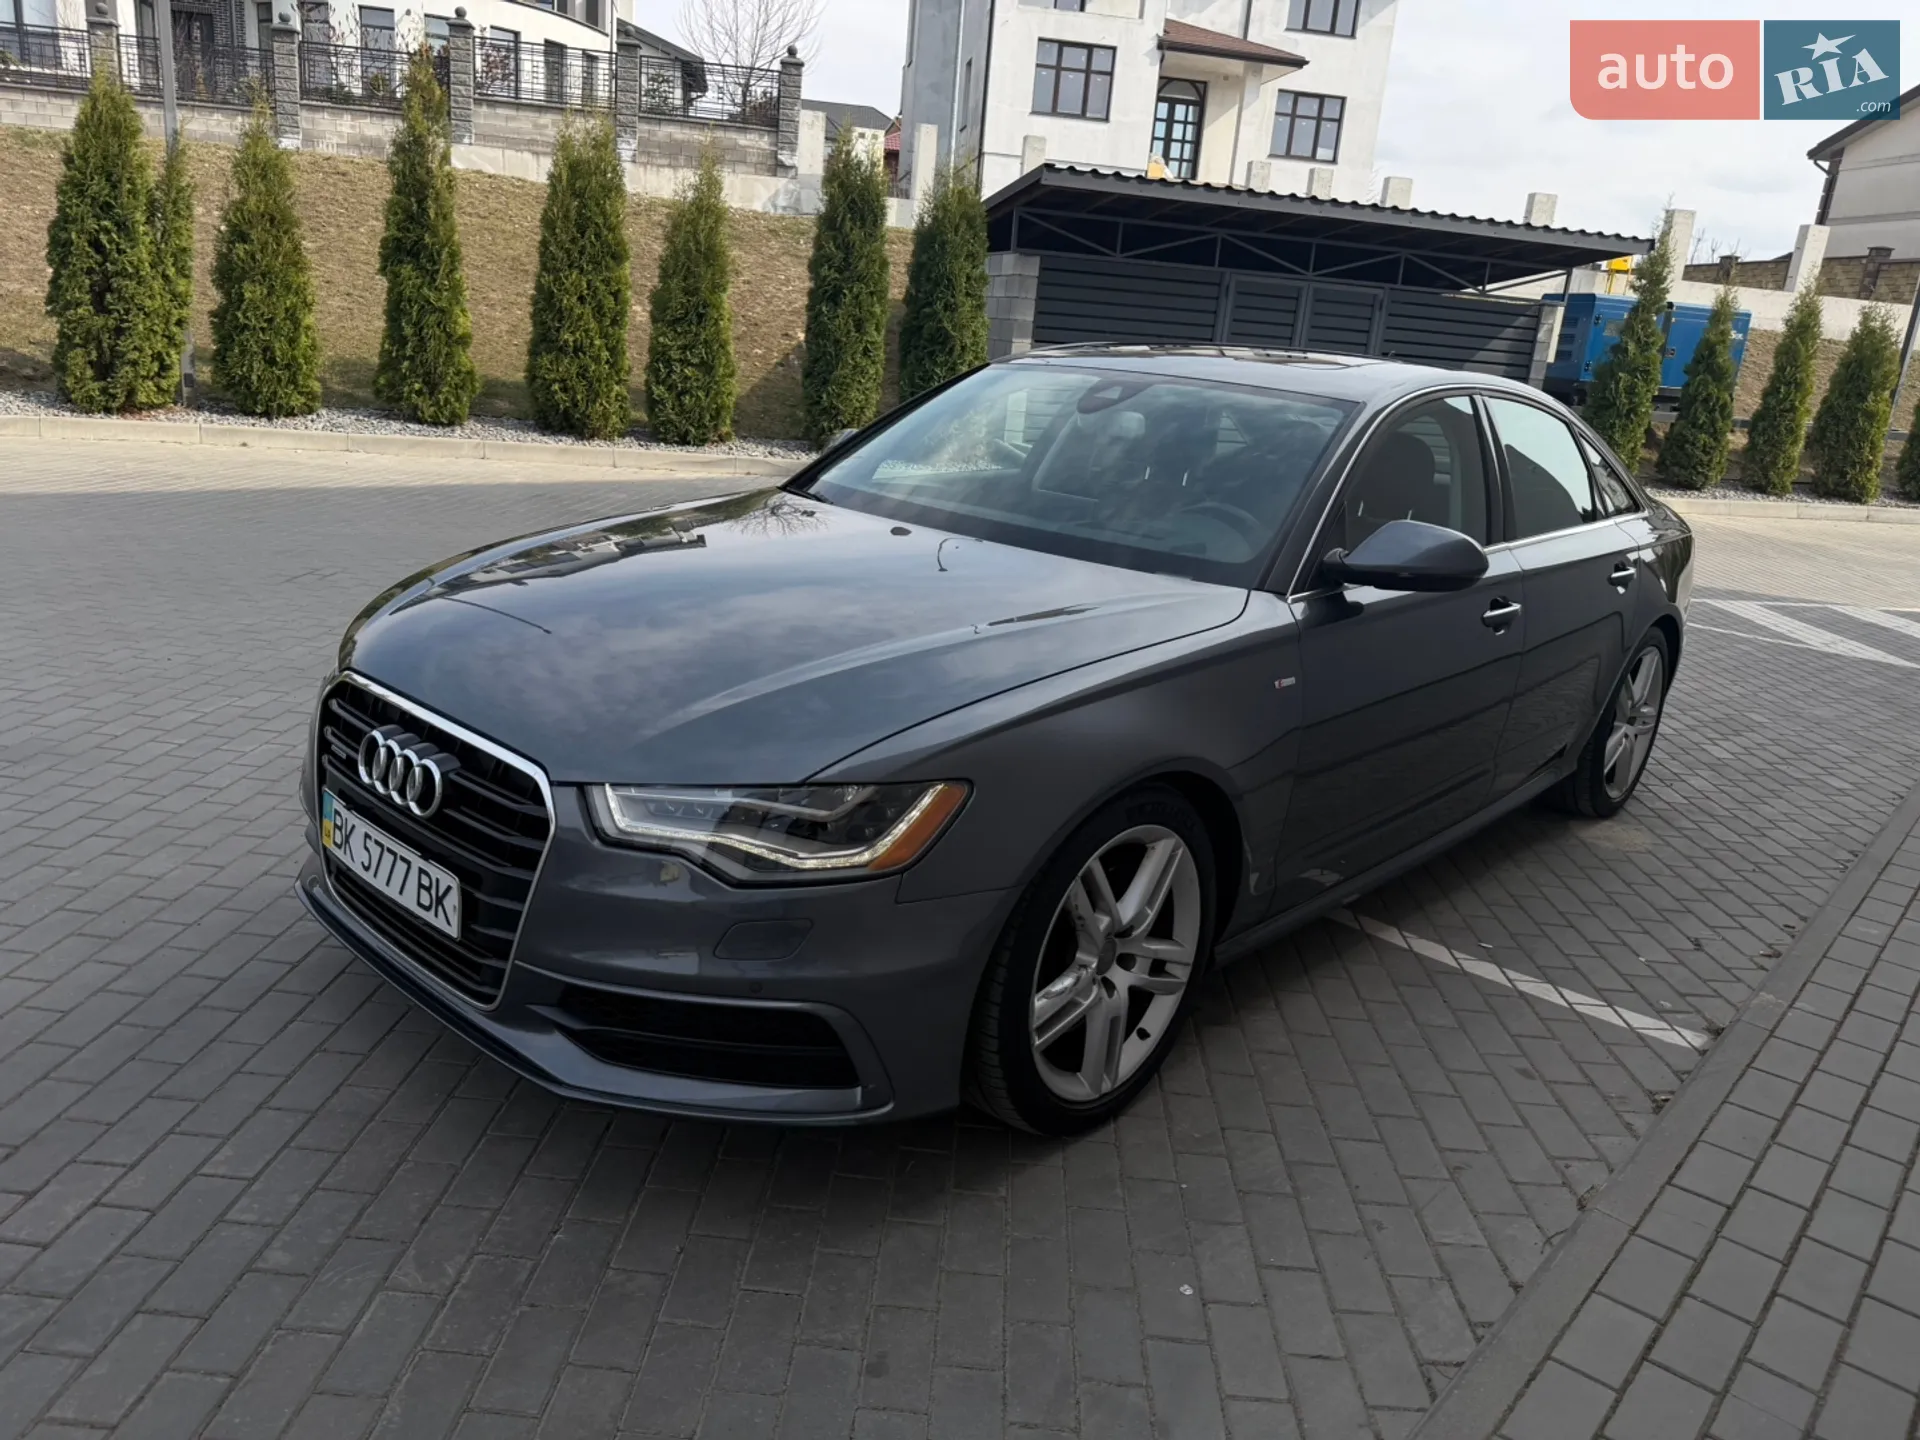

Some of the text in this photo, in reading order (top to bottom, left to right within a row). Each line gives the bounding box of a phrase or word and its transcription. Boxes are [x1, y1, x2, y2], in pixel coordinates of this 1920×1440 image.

[332, 808, 453, 928] BK 5777 BK
